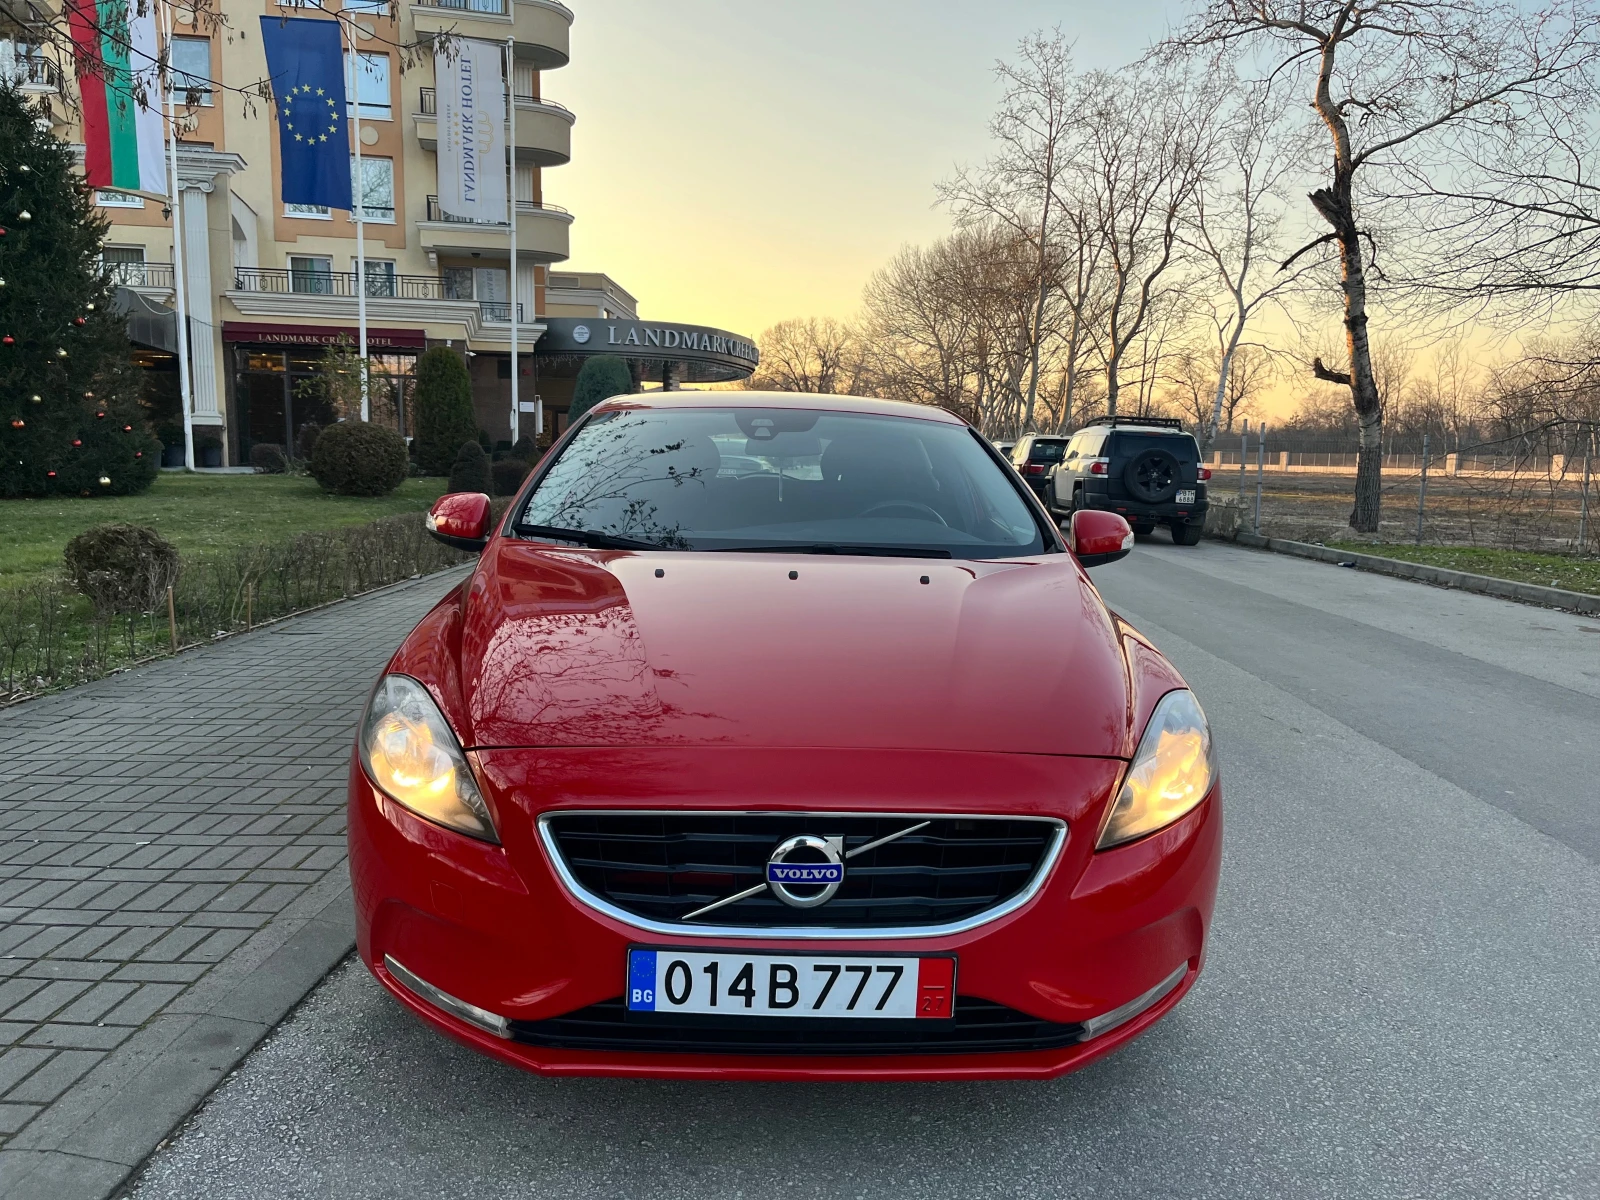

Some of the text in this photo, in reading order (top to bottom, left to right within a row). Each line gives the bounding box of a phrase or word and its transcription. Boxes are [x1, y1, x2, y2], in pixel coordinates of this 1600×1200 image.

[258, 332, 393, 346] LANDMARK CREK OTEL
[607, 325, 728, 354] LANDMARK
[773, 868, 838, 879] VOLVO
[632, 988, 653, 1003] BG
[922, 996, 945, 1011] 27
